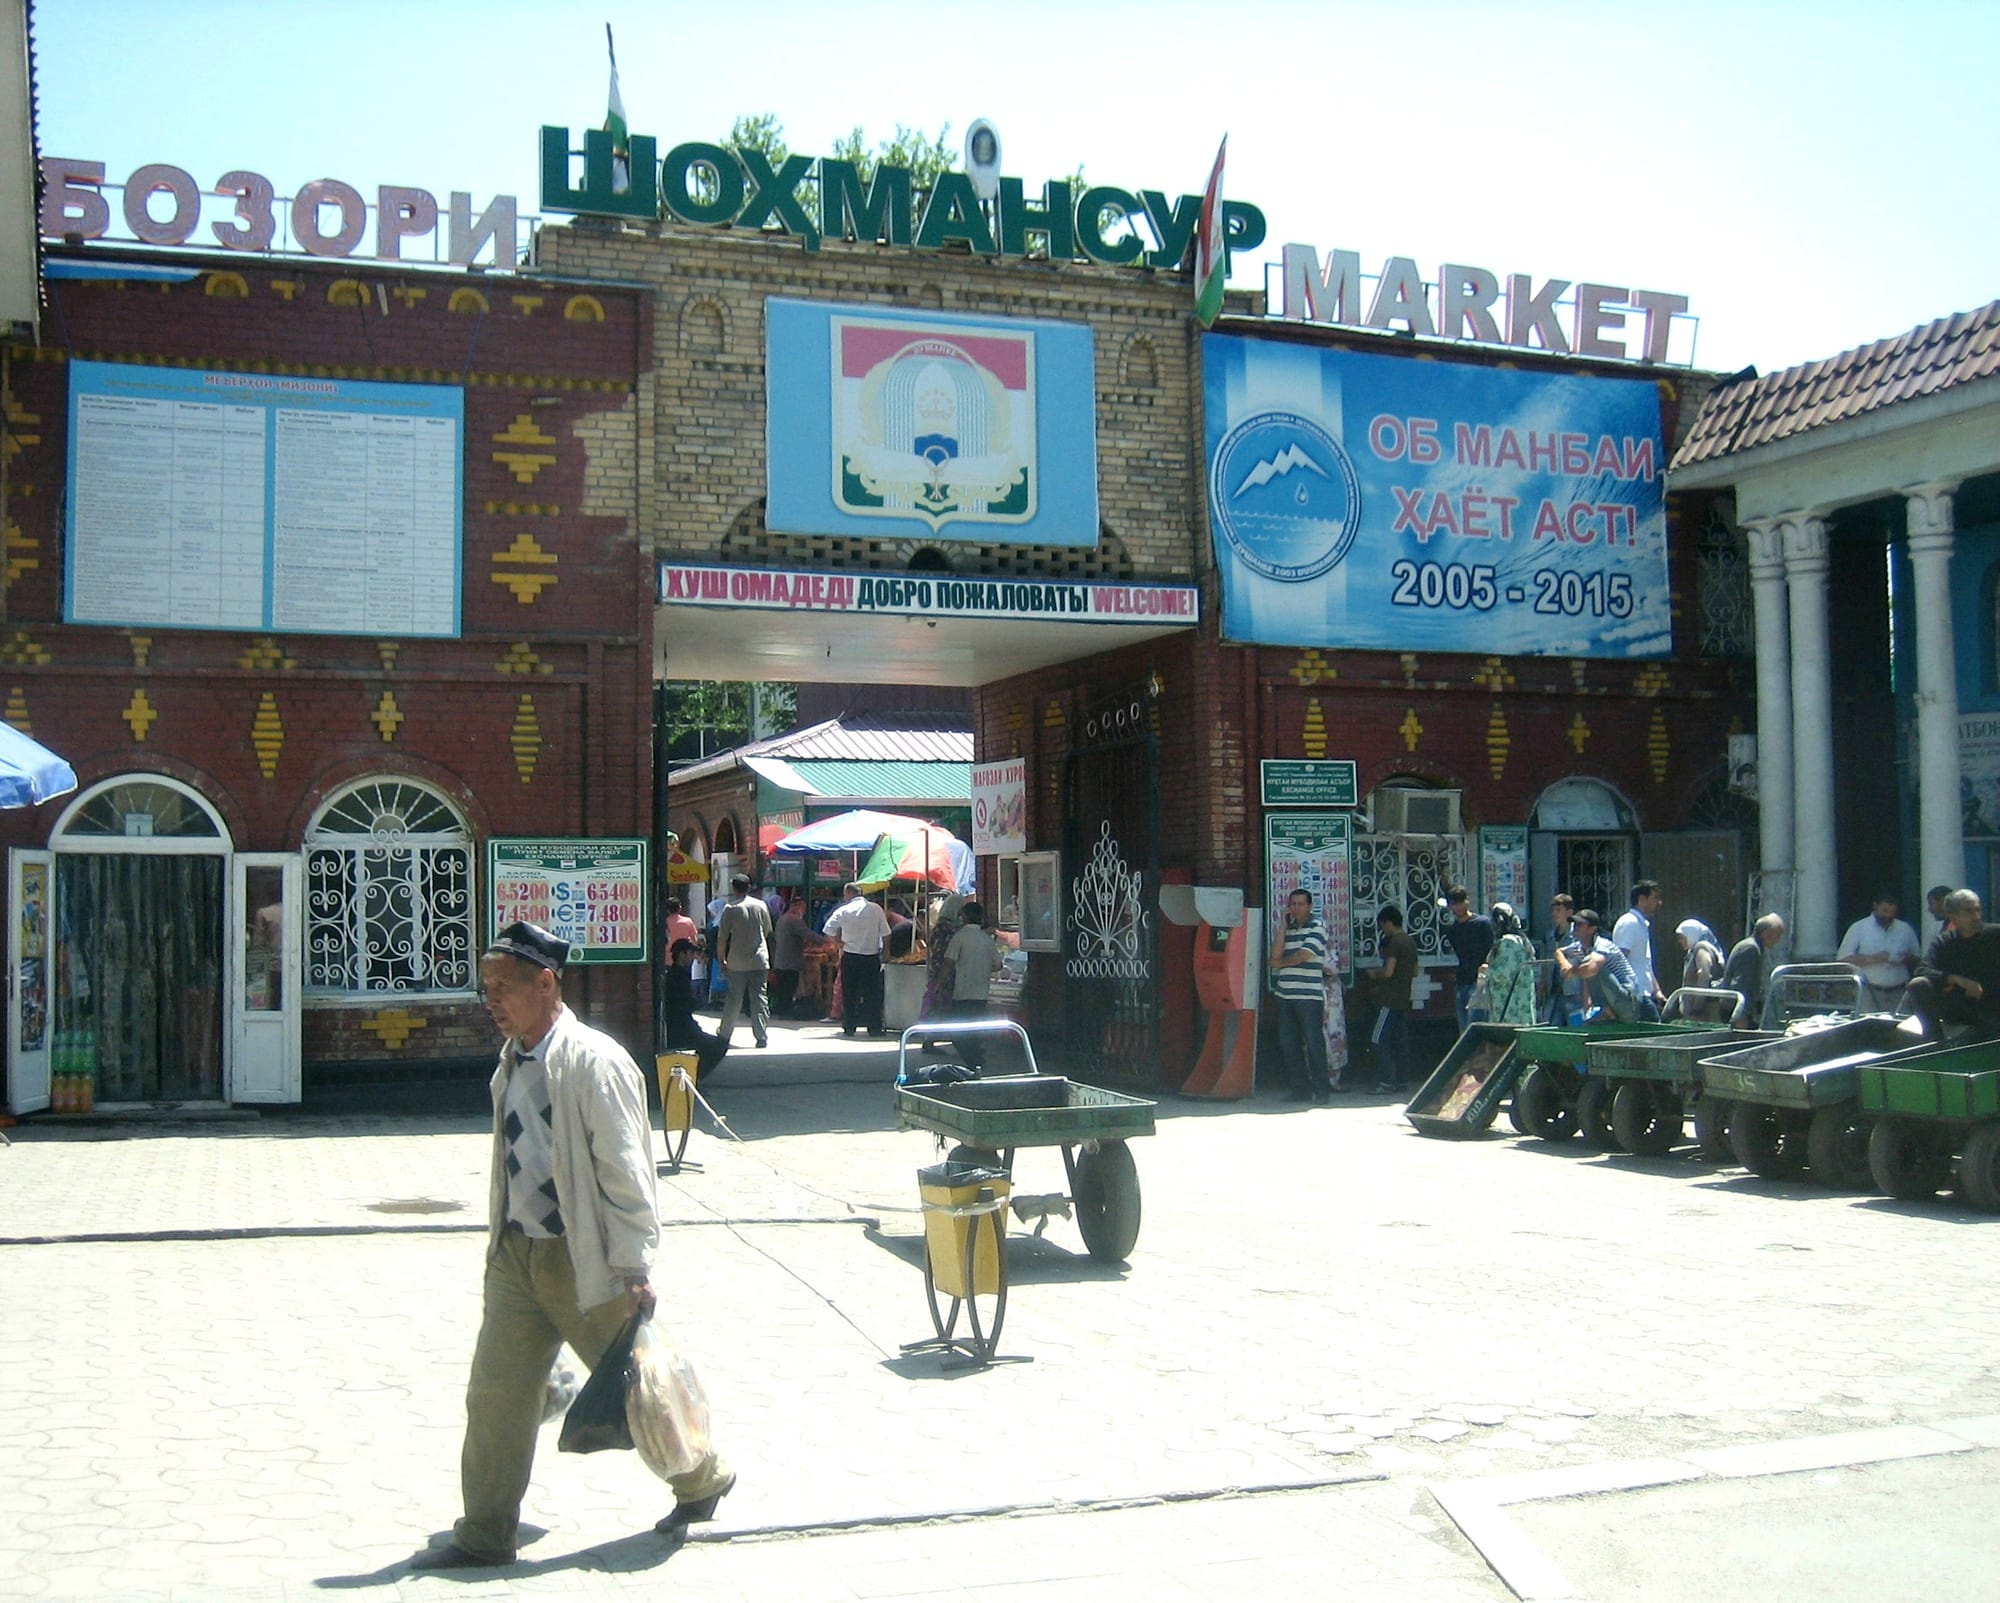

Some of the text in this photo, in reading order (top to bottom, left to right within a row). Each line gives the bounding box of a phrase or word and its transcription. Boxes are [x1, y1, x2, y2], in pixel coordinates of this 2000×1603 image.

[42, 154, 517, 273] БОЗОРИ
[1284, 242, 1688, 366] MARKET
[1368, 414, 1654, 482] ОБ МАНБАИ
[1392, 486, 1520, 543] ҲАЁТ
[1532, 501, 1637, 547] АСТ!
[666, 569, 1195, 617] ХУШ ОМАДЕД! ДОБРО ПОЖАЛОВАТЬ! WELCOME!
[1274, 567, 1297, 577] 2003
[1391, 559, 1496, 612] 2005
[1534, 570, 1634, 617] 2015
